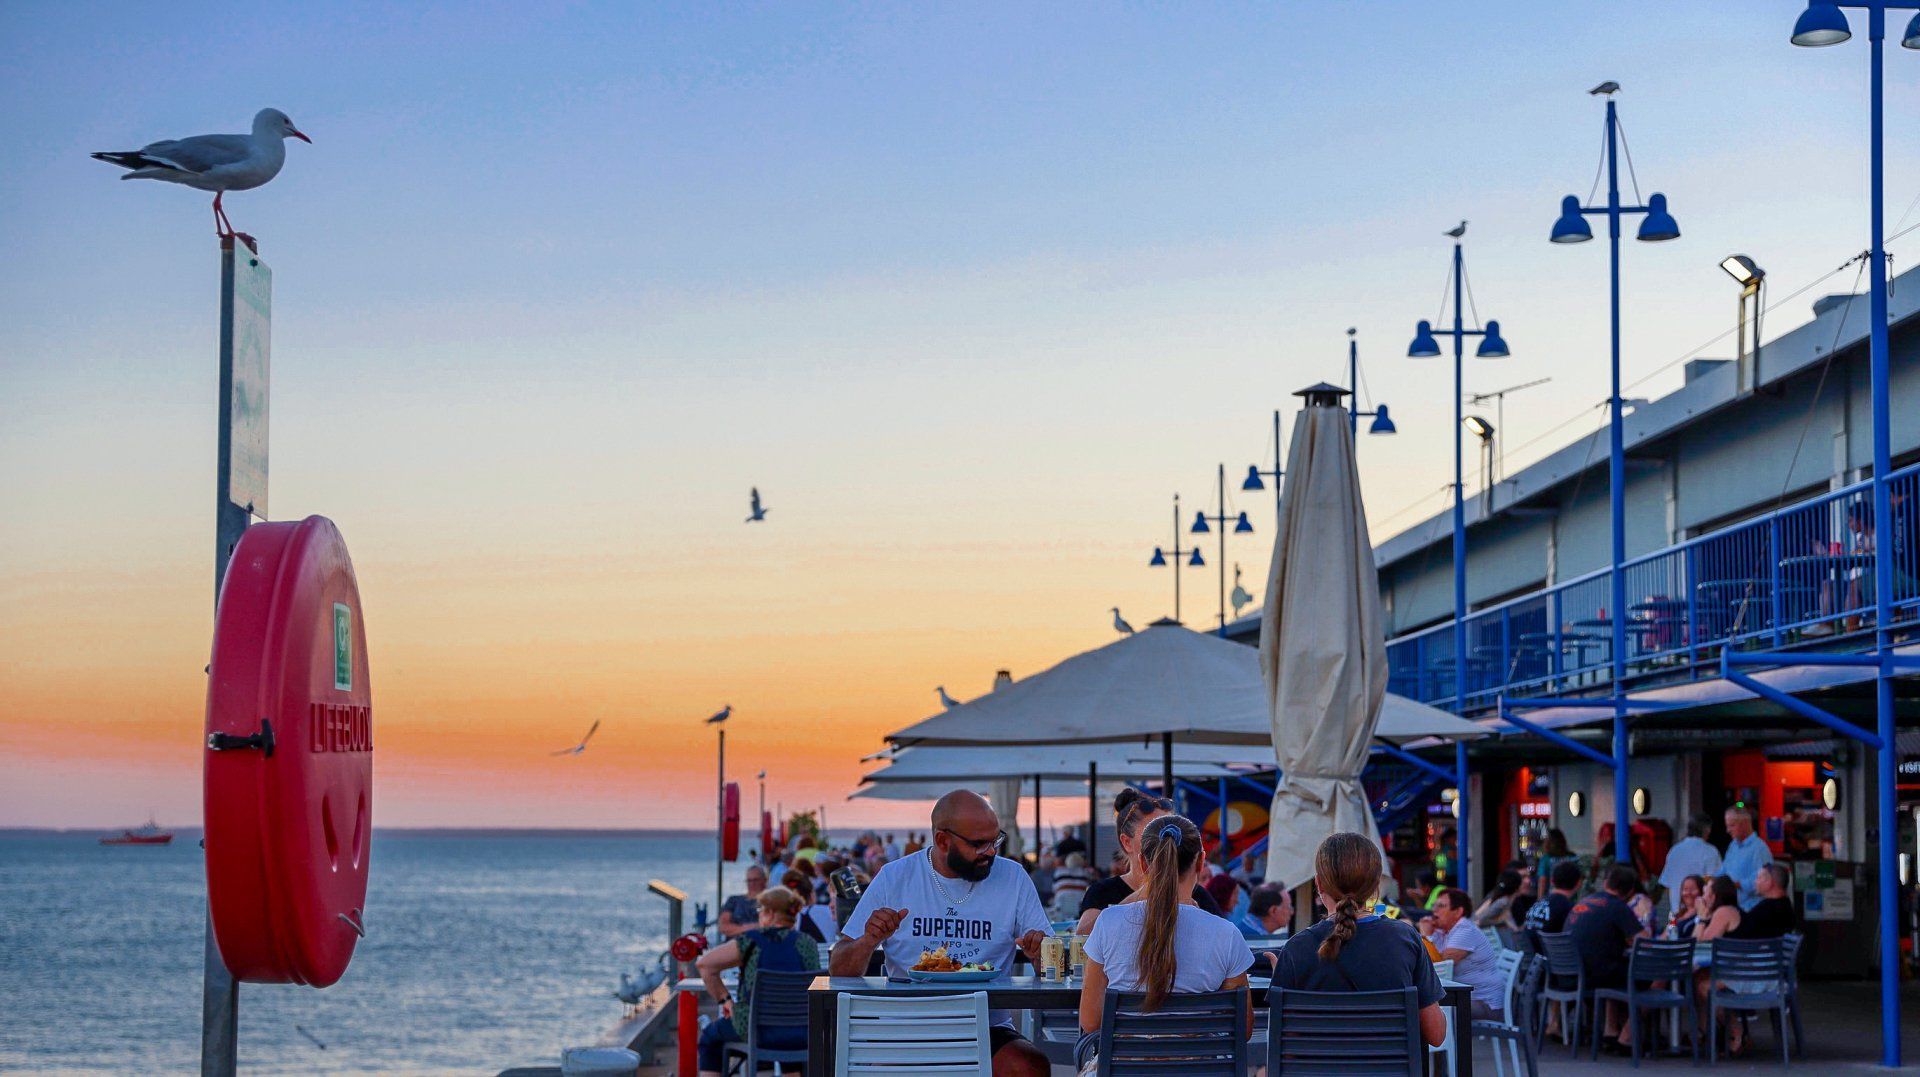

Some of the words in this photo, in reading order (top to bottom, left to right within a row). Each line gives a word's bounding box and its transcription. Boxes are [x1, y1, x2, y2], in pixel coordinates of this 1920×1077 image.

[946, 907, 958, 916] The
[912, 917, 992, 940] SUPERIOR
[923, 945, 980, 960] WOKSHOP
